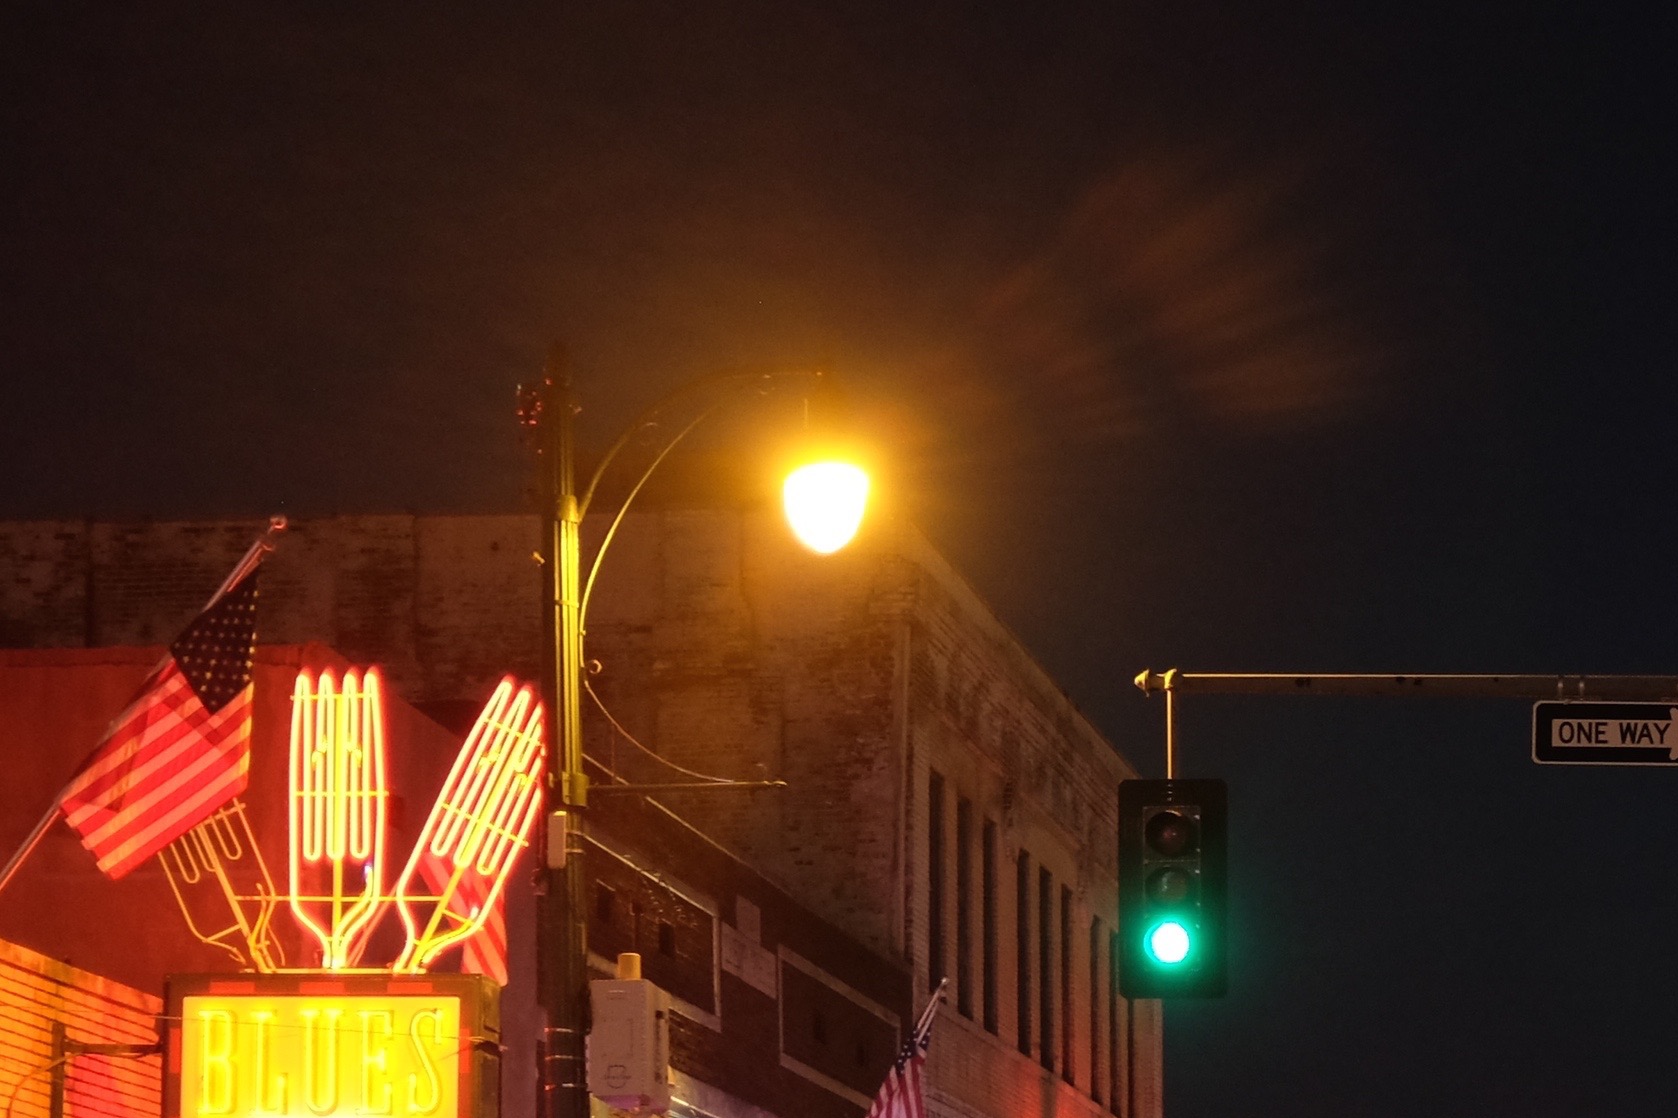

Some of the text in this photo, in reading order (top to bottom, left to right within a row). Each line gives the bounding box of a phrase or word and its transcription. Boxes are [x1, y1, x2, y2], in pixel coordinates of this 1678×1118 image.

[1558, 721, 1670, 745] ONE WAY
[197, 1008, 445, 1116] BLUES
